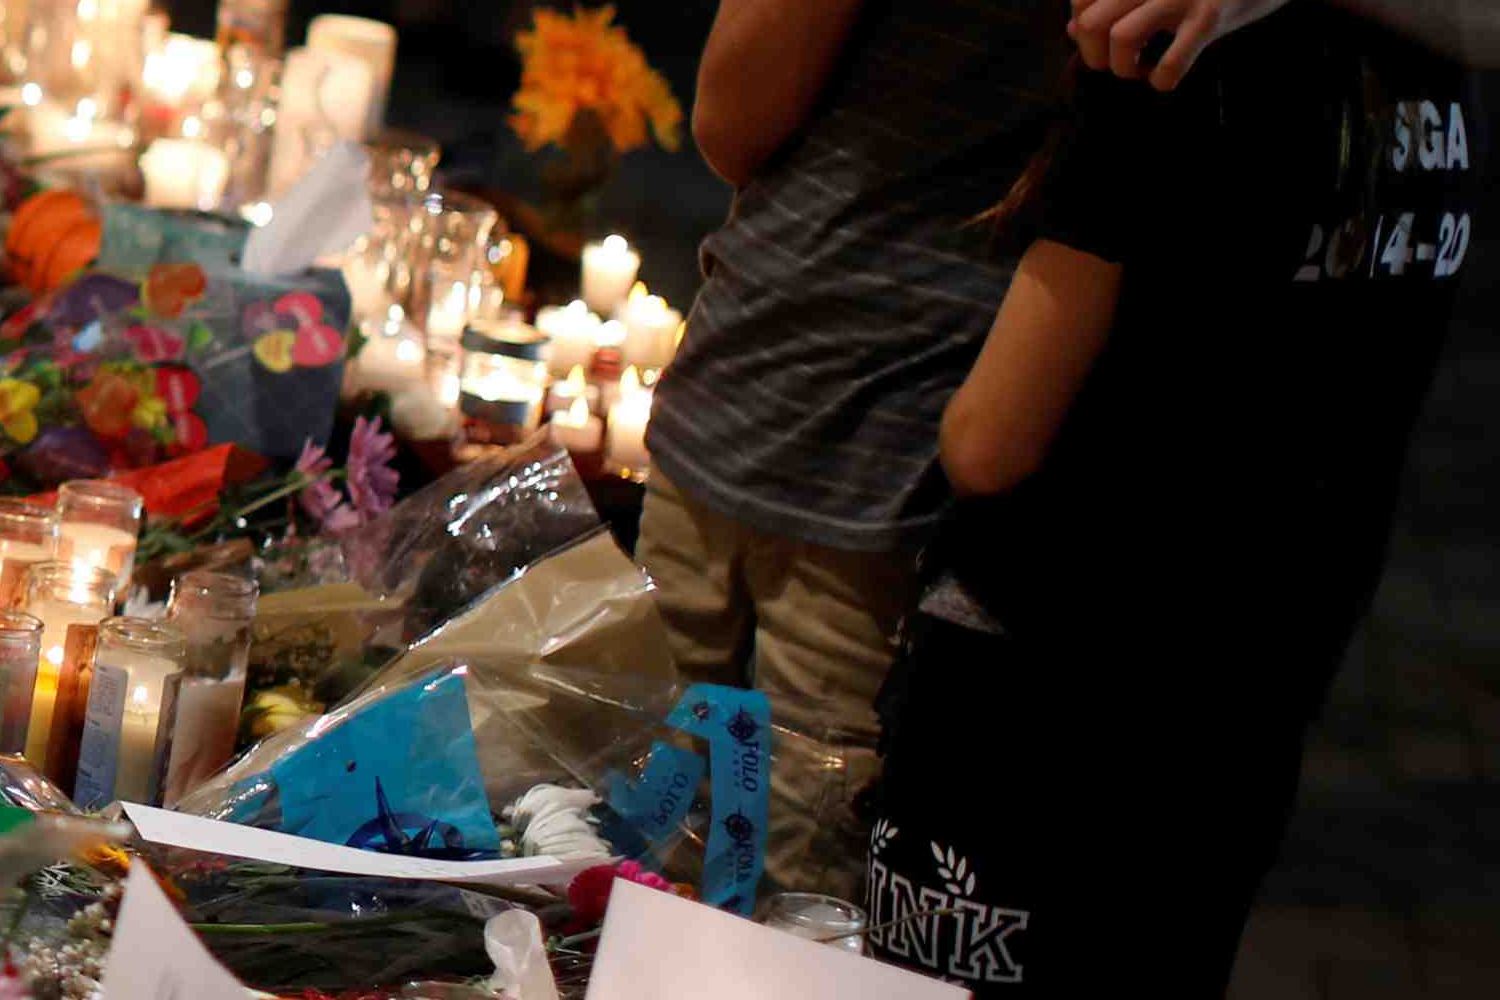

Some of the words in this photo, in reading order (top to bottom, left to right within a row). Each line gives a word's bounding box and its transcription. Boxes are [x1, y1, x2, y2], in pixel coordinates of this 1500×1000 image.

[1393, 99, 1469, 171] SGA
[740, 740, 759, 792] POLO
[865, 856, 1030, 982] INK
